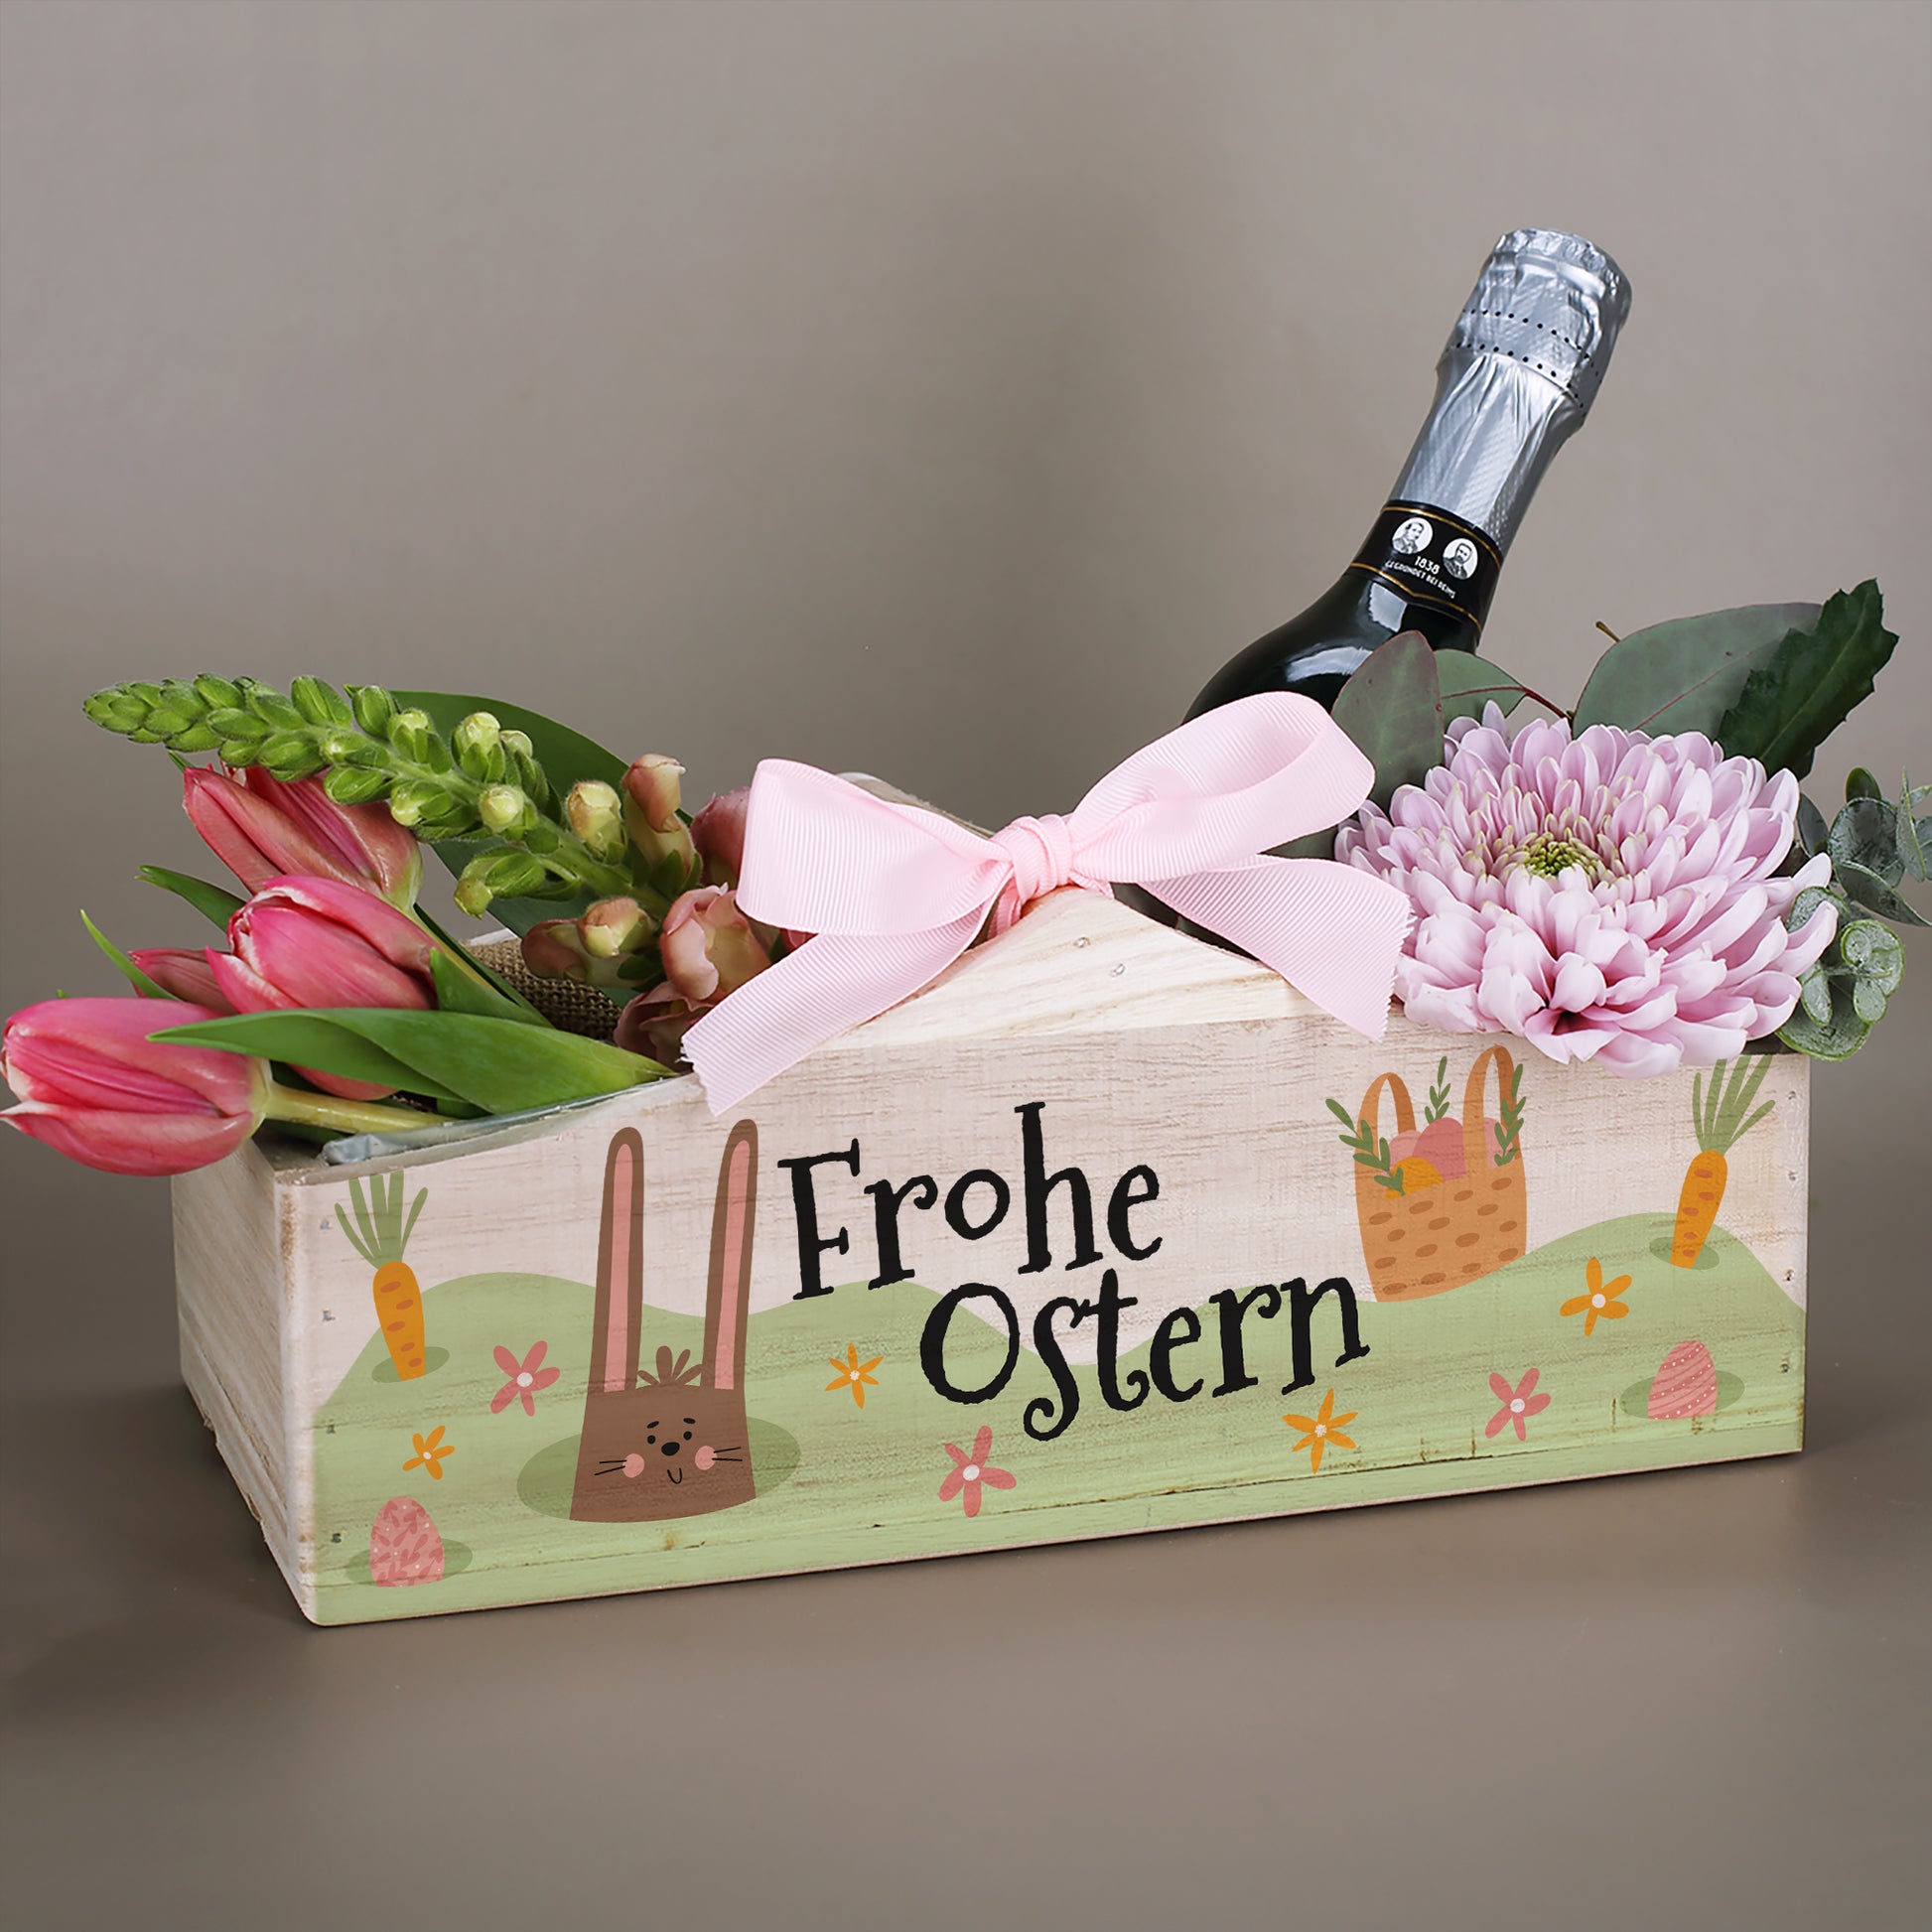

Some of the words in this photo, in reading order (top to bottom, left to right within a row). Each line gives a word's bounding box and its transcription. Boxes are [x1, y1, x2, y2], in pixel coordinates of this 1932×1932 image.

[1415, 556, 1440, 574] 1838
[777, 1102, 1163, 1301] Frohe
[919, 1268, 1371, 1442] Ostern
